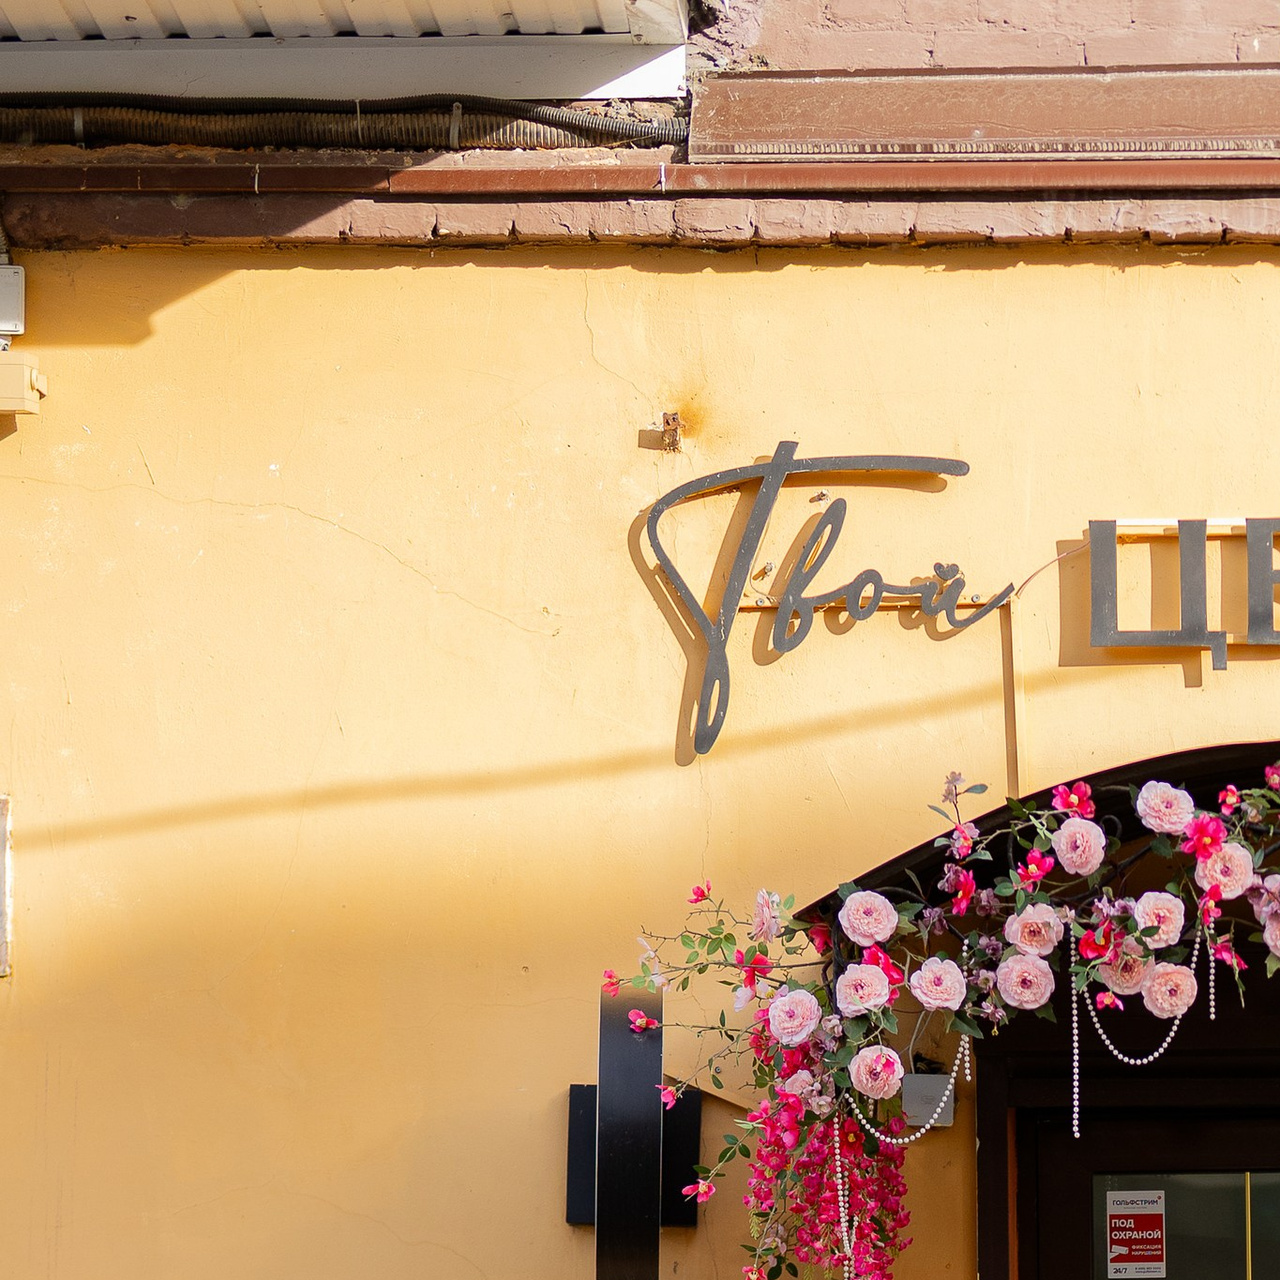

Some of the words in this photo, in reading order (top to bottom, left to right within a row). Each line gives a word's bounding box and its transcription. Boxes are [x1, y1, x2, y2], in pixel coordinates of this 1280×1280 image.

[647, 440, 1015, 755] Твой
[1112, 1219, 1134, 1228] ПОД
[1112, 1229, 1161, 1239] ОХРАНОЙ
